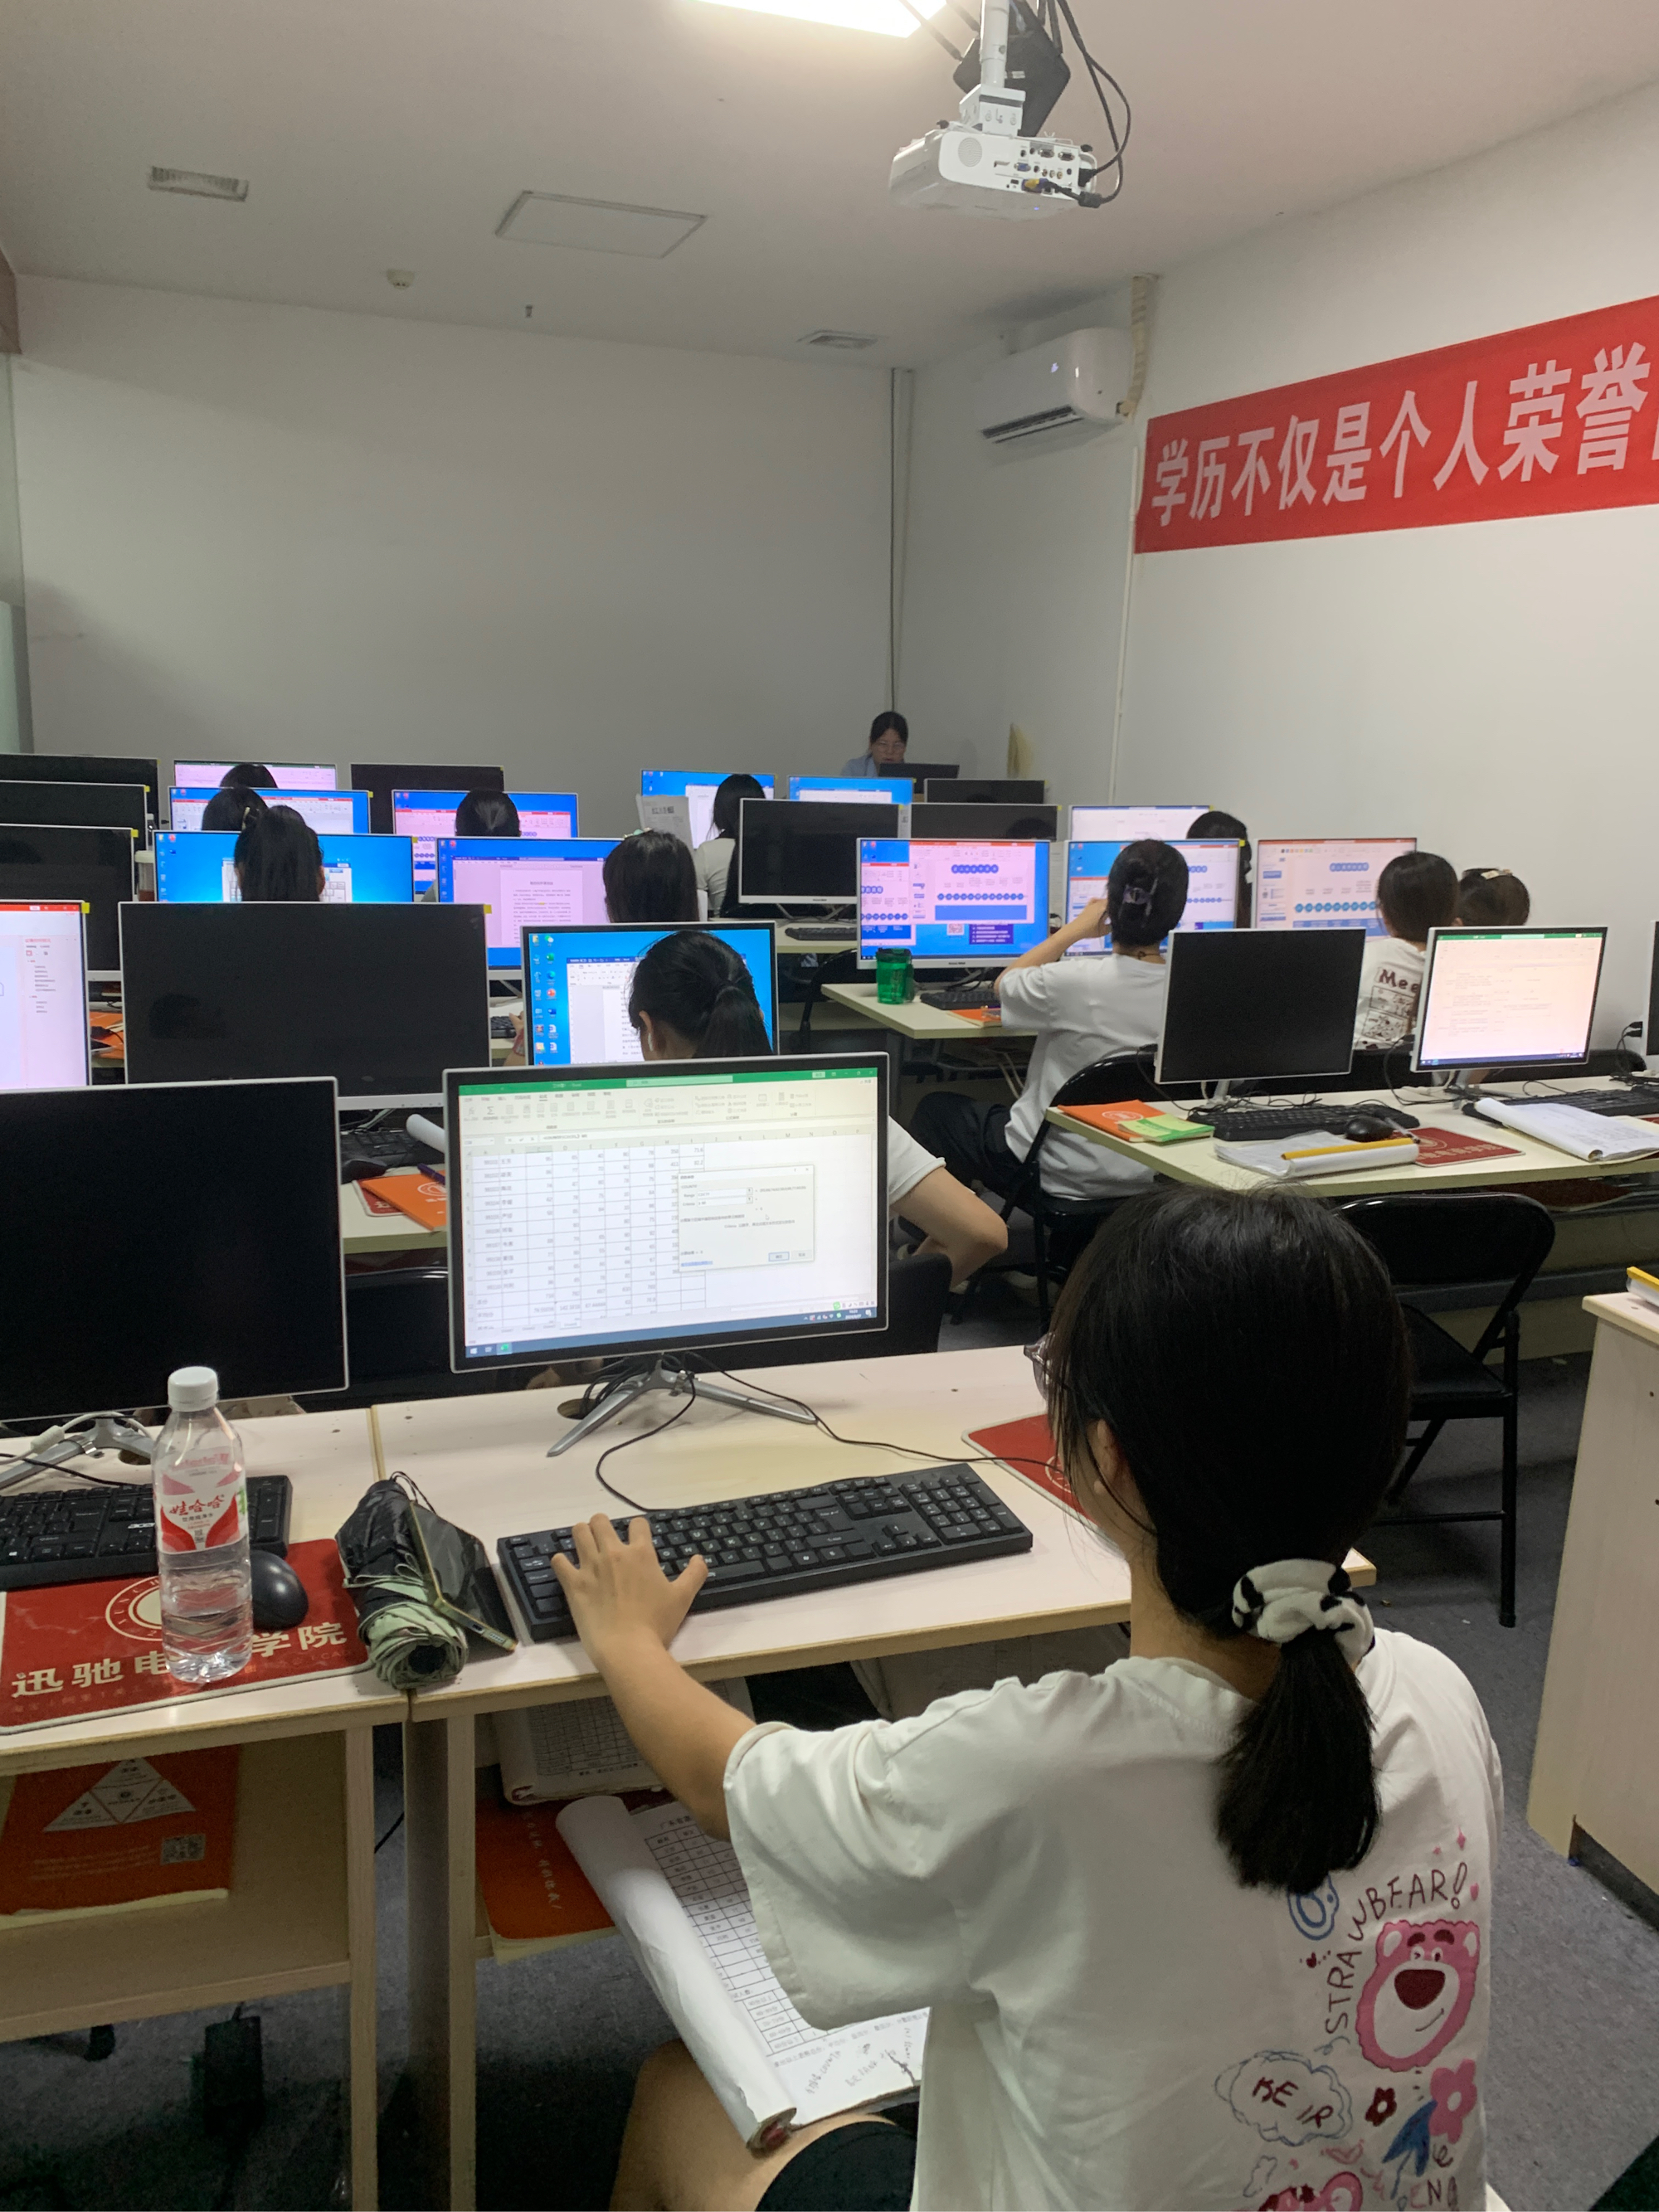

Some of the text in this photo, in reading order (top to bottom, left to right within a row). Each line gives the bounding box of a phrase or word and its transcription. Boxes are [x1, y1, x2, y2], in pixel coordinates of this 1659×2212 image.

[1151, 342, 1659, 527] 学历不仅是个人荣誉
[169, 1495, 224, 1515] 娃哈哈
[11, 1621, 348, 1699] 迅驰电学院
